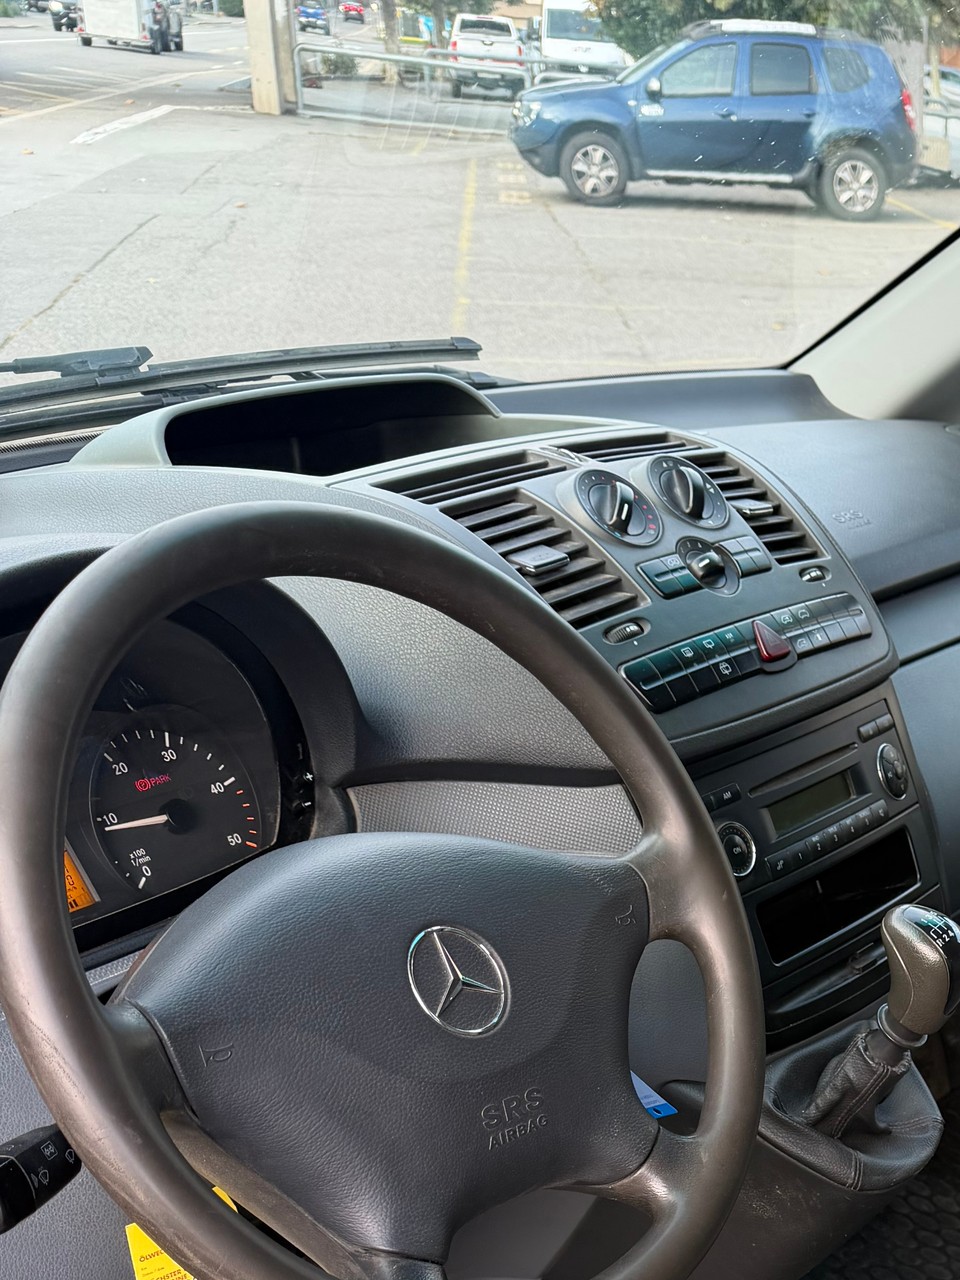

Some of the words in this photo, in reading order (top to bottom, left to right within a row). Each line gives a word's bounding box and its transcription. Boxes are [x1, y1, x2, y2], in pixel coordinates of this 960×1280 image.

[161, 749, 177, 762] 30
[112, 762, 129, 775] 20
[210, 783, 224, 794] 40
[103, 812, 118, 825] 10
[227, 833, 242, 846] 50
[142, 865, 152, 877] 0
[481, 1086, 544, 1130] SRS
[489, 1114, 548, 1151] AIRBAG
